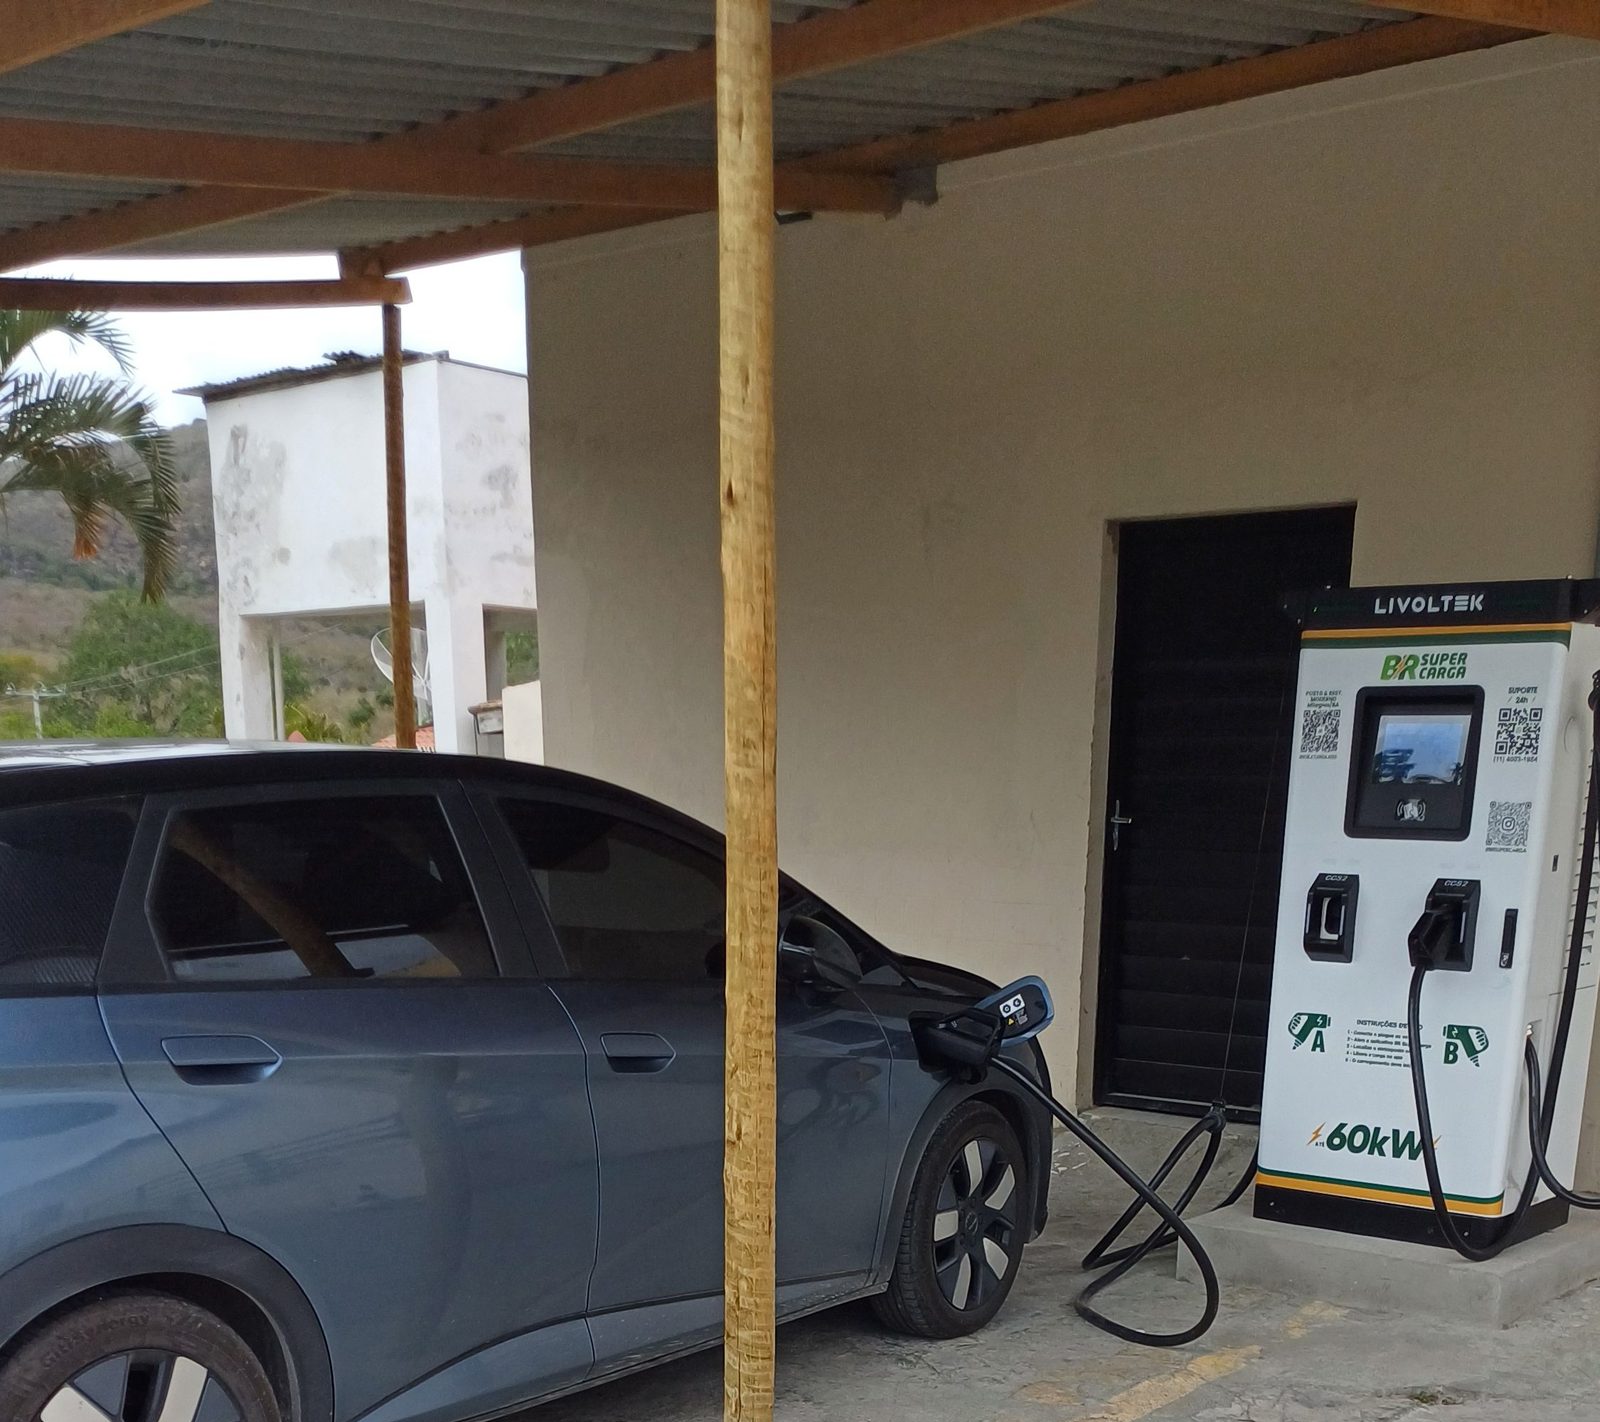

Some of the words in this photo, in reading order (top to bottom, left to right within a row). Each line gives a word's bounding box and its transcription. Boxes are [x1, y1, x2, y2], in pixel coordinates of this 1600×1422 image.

[1374, 594, 1485, 615] LIVOLTEK
[1380, 654, 1420, 680] BR
[1420, 652, 1468, 666] SUPER
[1418, 666, 1467, 680] CARGA
[1508, 686, 1538, 694] SUPORTE
[1325, 874, 1349, 882] CCS2
[1444, 879, 1469, 887] CCS2
[1311, 1030, 1326, 1053] A
[1443, 1041, 1459, 1065] B
[1326, 1122, 1423, 1161] 60kW
